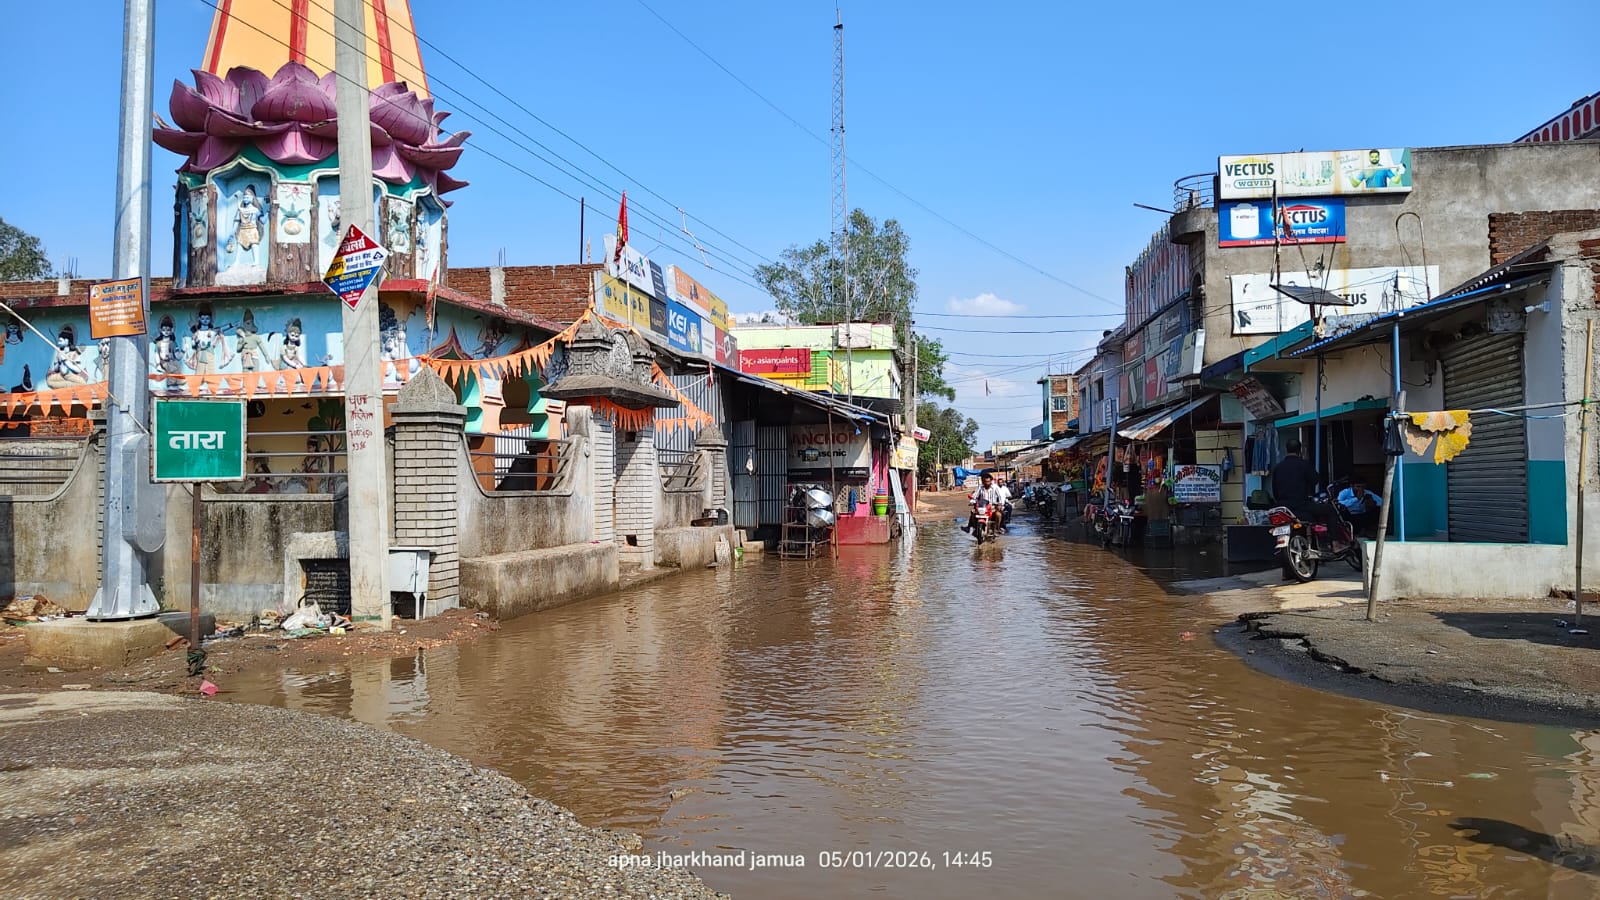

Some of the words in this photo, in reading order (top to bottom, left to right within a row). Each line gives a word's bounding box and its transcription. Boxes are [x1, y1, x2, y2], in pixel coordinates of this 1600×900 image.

[1225, 163, 1274, 176] VECTUS
[669, 310, 687, 333] KEI
[757, 356, 798, 365] asianpaints
[168, 431, 226, 449] तारा
[798, 449, 847, 457] Pasonic
